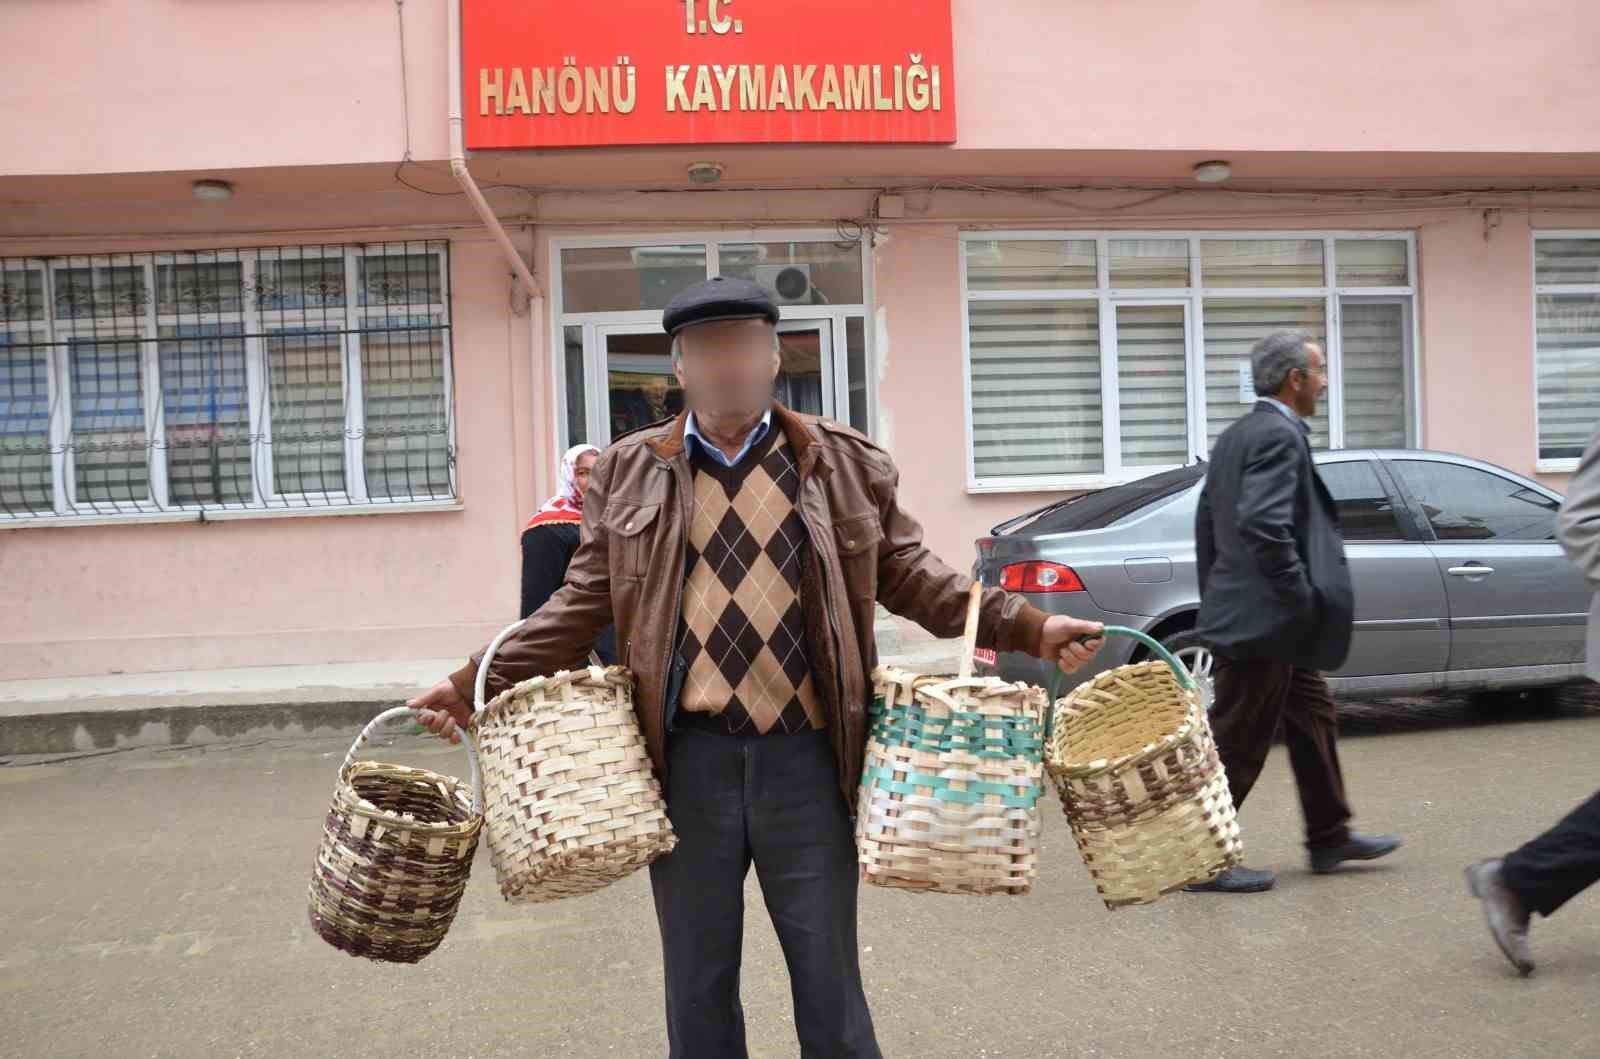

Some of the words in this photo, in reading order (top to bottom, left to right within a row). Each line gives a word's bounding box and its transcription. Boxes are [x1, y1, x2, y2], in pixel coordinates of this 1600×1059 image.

[681, 0, 743, 34] T.C.
[479, 55, 636, 116] HANÖNÜ
[664, 52, 941, 112] KAYMAKAMLIĞI
